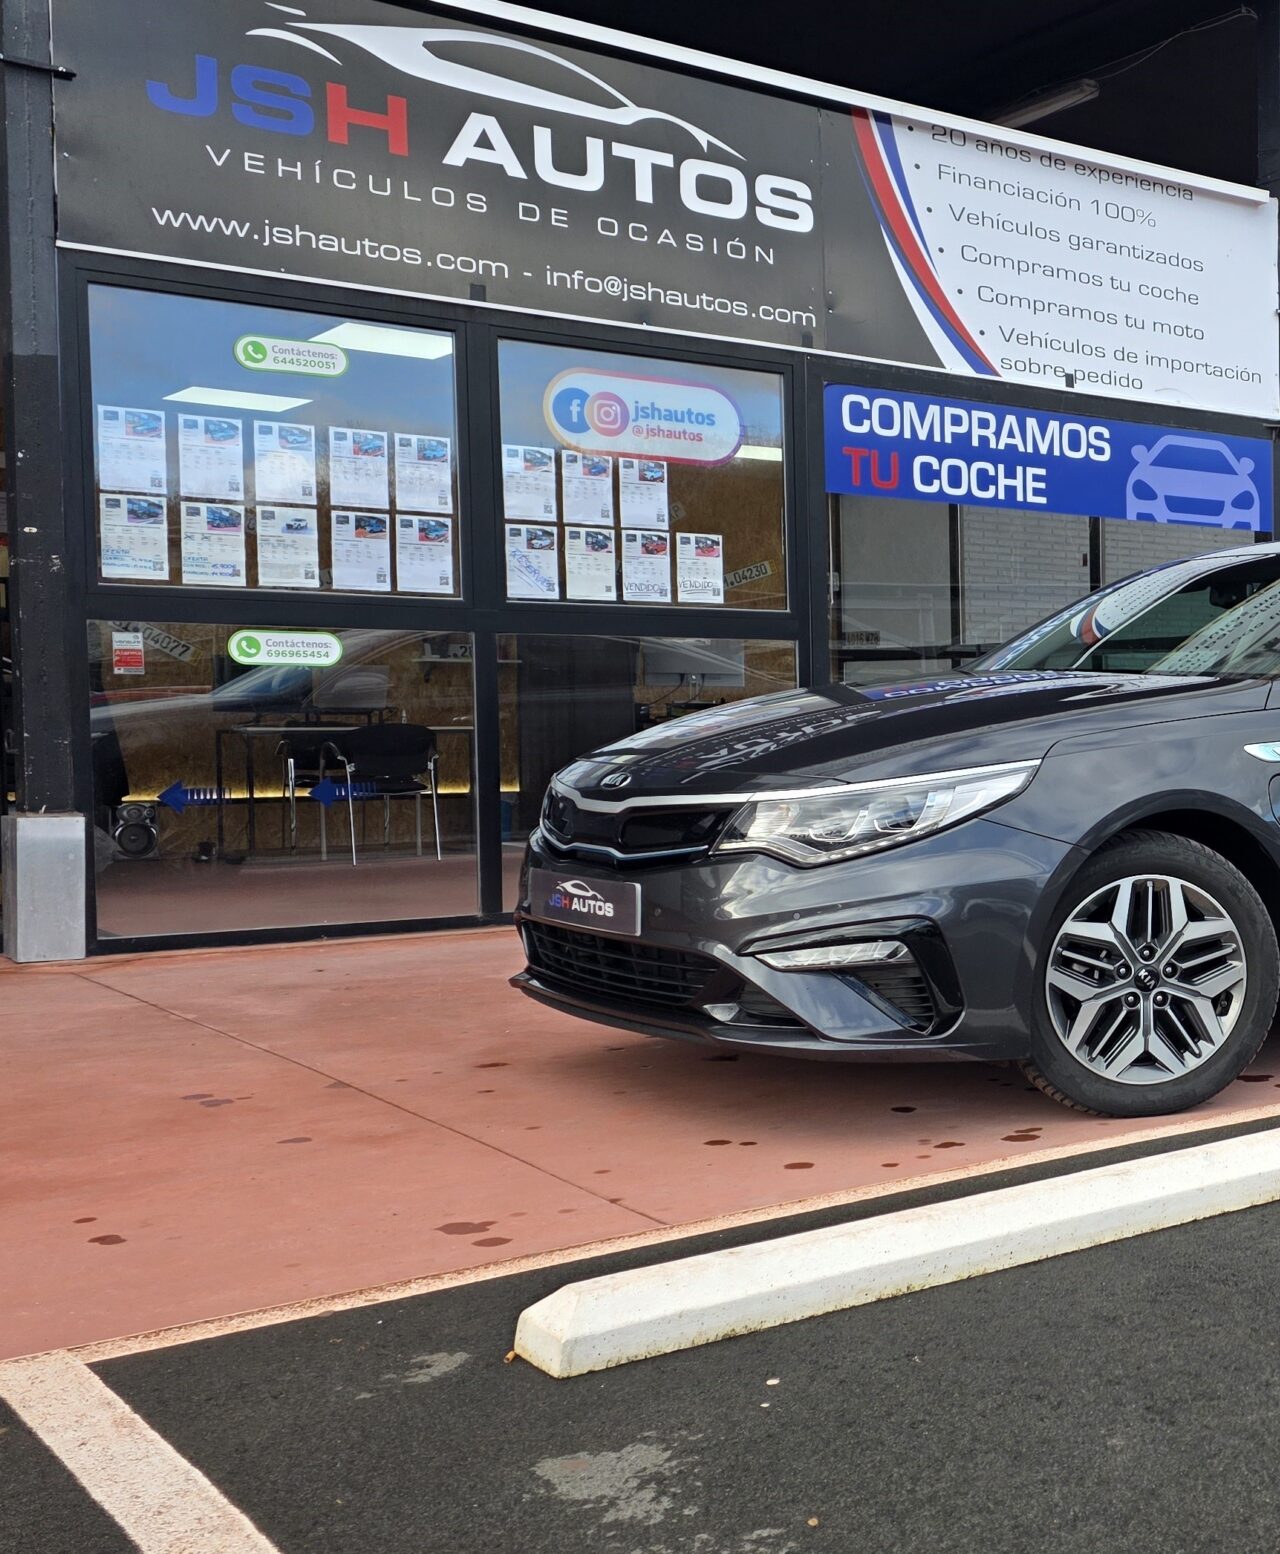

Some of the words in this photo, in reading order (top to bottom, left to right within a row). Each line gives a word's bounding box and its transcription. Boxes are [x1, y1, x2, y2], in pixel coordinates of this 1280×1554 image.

[145, 53, 409, 157] JSH
[442, 112, 814, 233] AUTOS
[931, 124, 967, 148] 20
[975, 138, 1032, 163] años
[1039, 148, 1068, 173] de
[1073, 161, 1195, 202] experiencia
[205, 144, 488, 213] VEHÍCULOS
[518, 201, 570, 228] DE
[596, 216, 775, 265] OCASIÓN
[937, 163, 1081, 213] Financiación
[1090, 199, 1158, 229] 100%
[948, 202, 1061, 244] Vehículos
[1068, 228, 1205, 273] garantizados
[151, 207, 509, 279] www.jshautos.com
[546, 264, 817, 327] info@jshautos.com
[960, 243, 1104, 289] Compramos
[1109, 272, 1133, 294] tu
[1137, 280, 1201, 306] coche
[976, 284, 1118, 328] Compramos
[1123, 310, 1146, 333] tu
[1151, 317, 1206, 342] moto
[272, 355, 337, 370] 644520051
[998, 324, 1106, 360] Vehículos
[1112, 343, 1139, 365] de
[1144, 347, 1263, 386] importación
[999, 353, 1066, 378] sobre
[1073, 367, 1144, 391] pedido
[631, 400, 717, 427] jshautos
[631, 424, 704, 443] @jshautos
[841, 392, 1112, 463] COMPRAMOS
[842, 446, 900, 491] TU
[911, 453, 1048, 505] COCHE
[624, 581, 661, 593] VENDIDO
[679, 578, 713, 589] VENDIDO
[265, 638, 332, 649] Contáctenos:
[266, 649, 330, 659] 696965454
[548, 892, 570, 909] JSH
[571, 898, 614, 917] AUTOS
[1138, 968, 1156, 989] KIA
